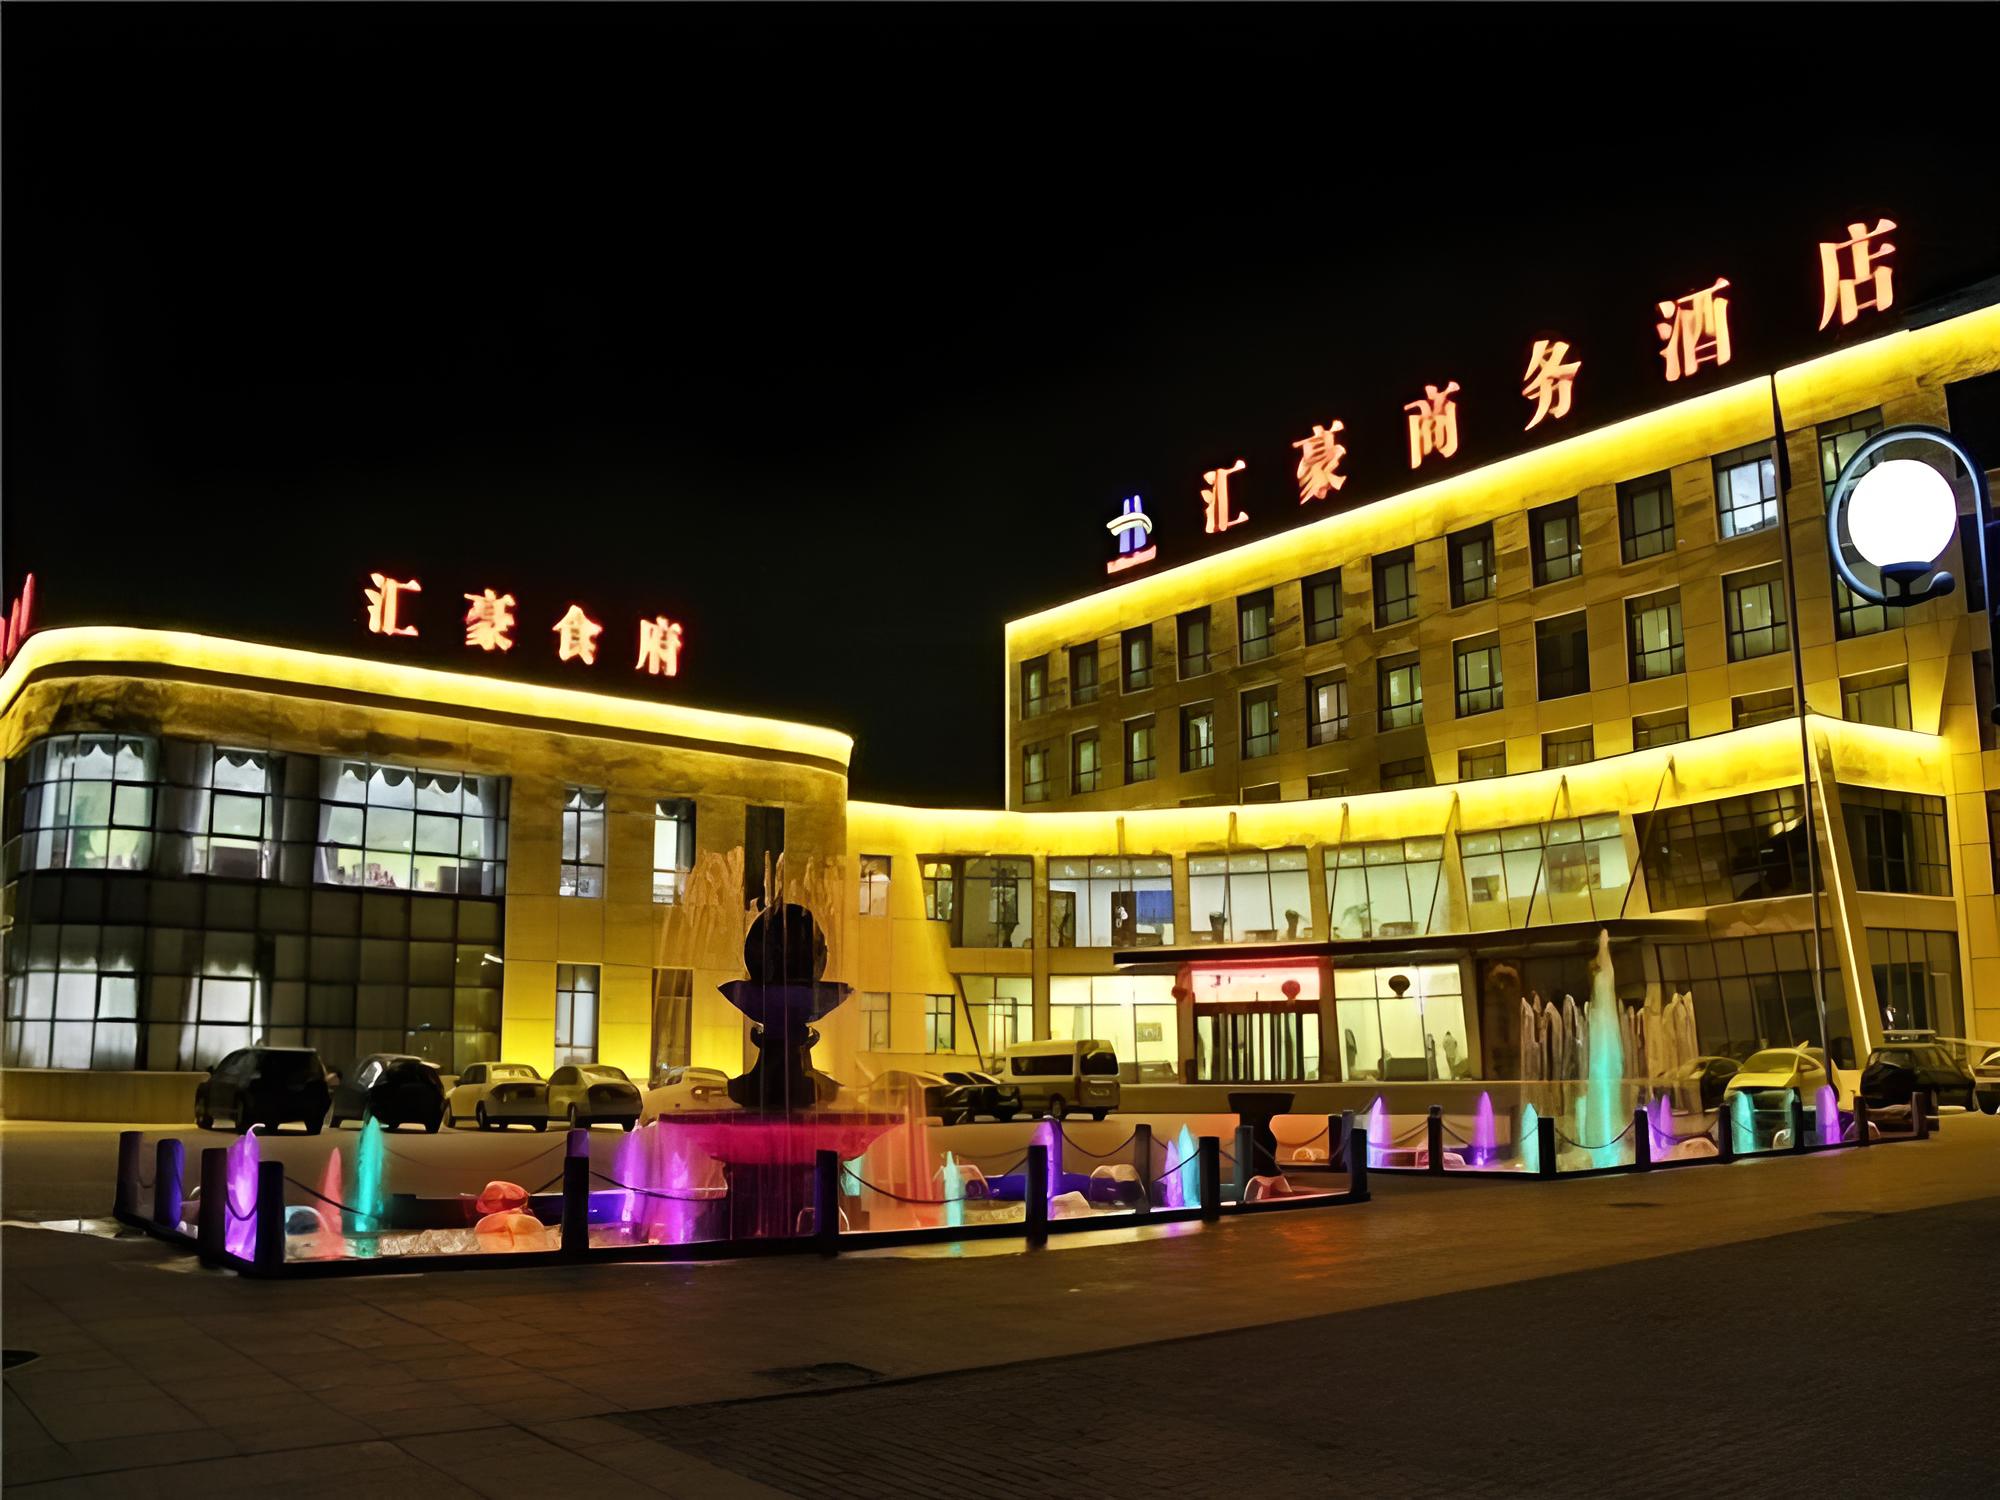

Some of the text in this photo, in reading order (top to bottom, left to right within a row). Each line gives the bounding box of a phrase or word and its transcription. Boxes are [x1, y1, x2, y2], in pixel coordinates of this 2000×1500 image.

[1201, 218, 1898, 534] 汇豪商务酒店
[364, 572, 684, 677] 汇豪食府
